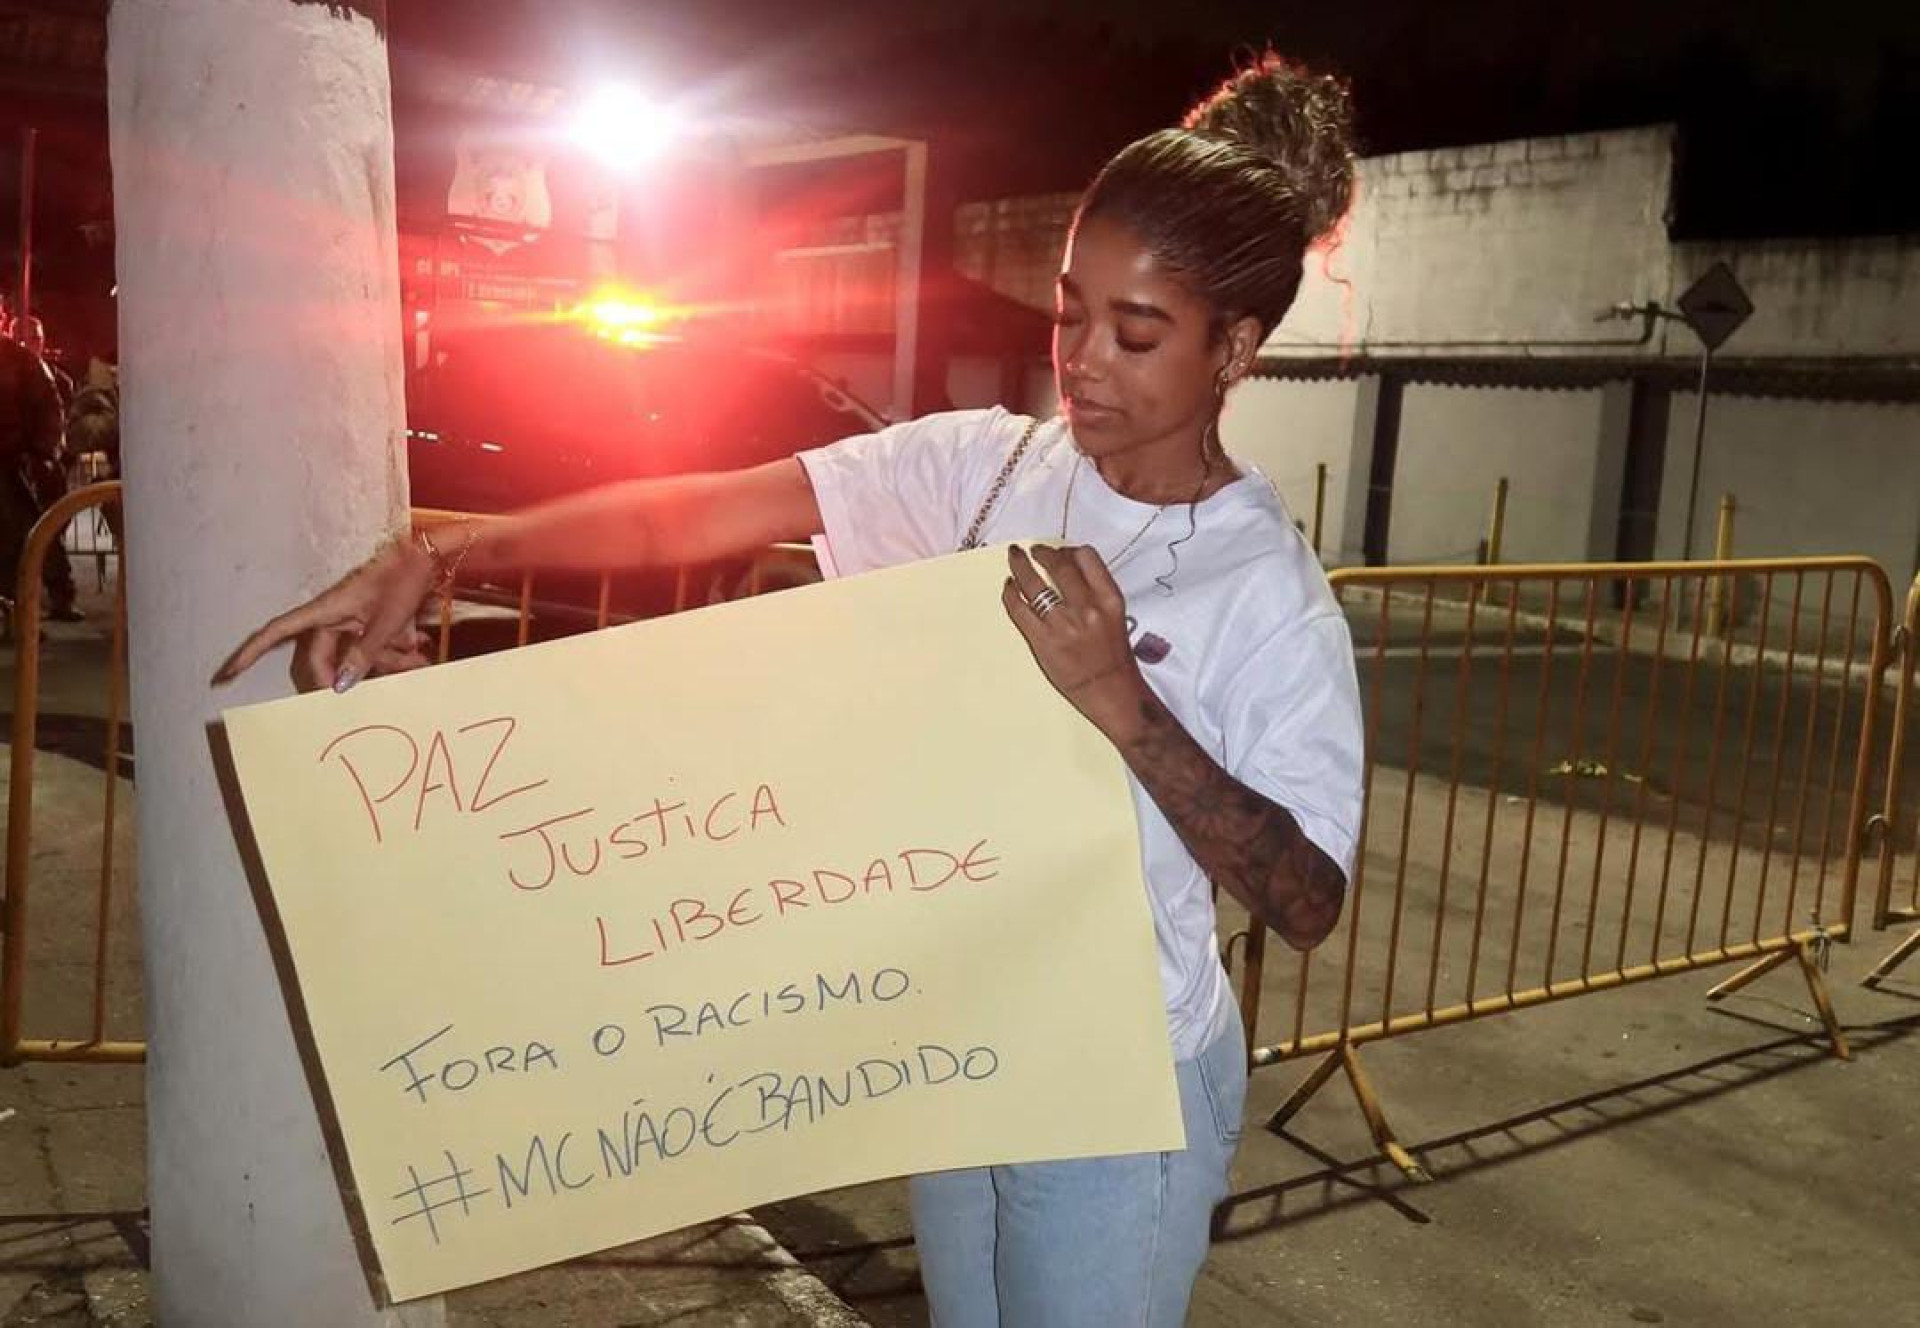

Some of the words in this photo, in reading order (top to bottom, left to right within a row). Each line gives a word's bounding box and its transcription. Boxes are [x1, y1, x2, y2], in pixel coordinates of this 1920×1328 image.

[320, 717, 548, 842] PAZ
[597, 838, 1001, 966] LIBERDADE
[380, 1025, 557, 1102] FORA
[593, 1024, 626, 1057] O
